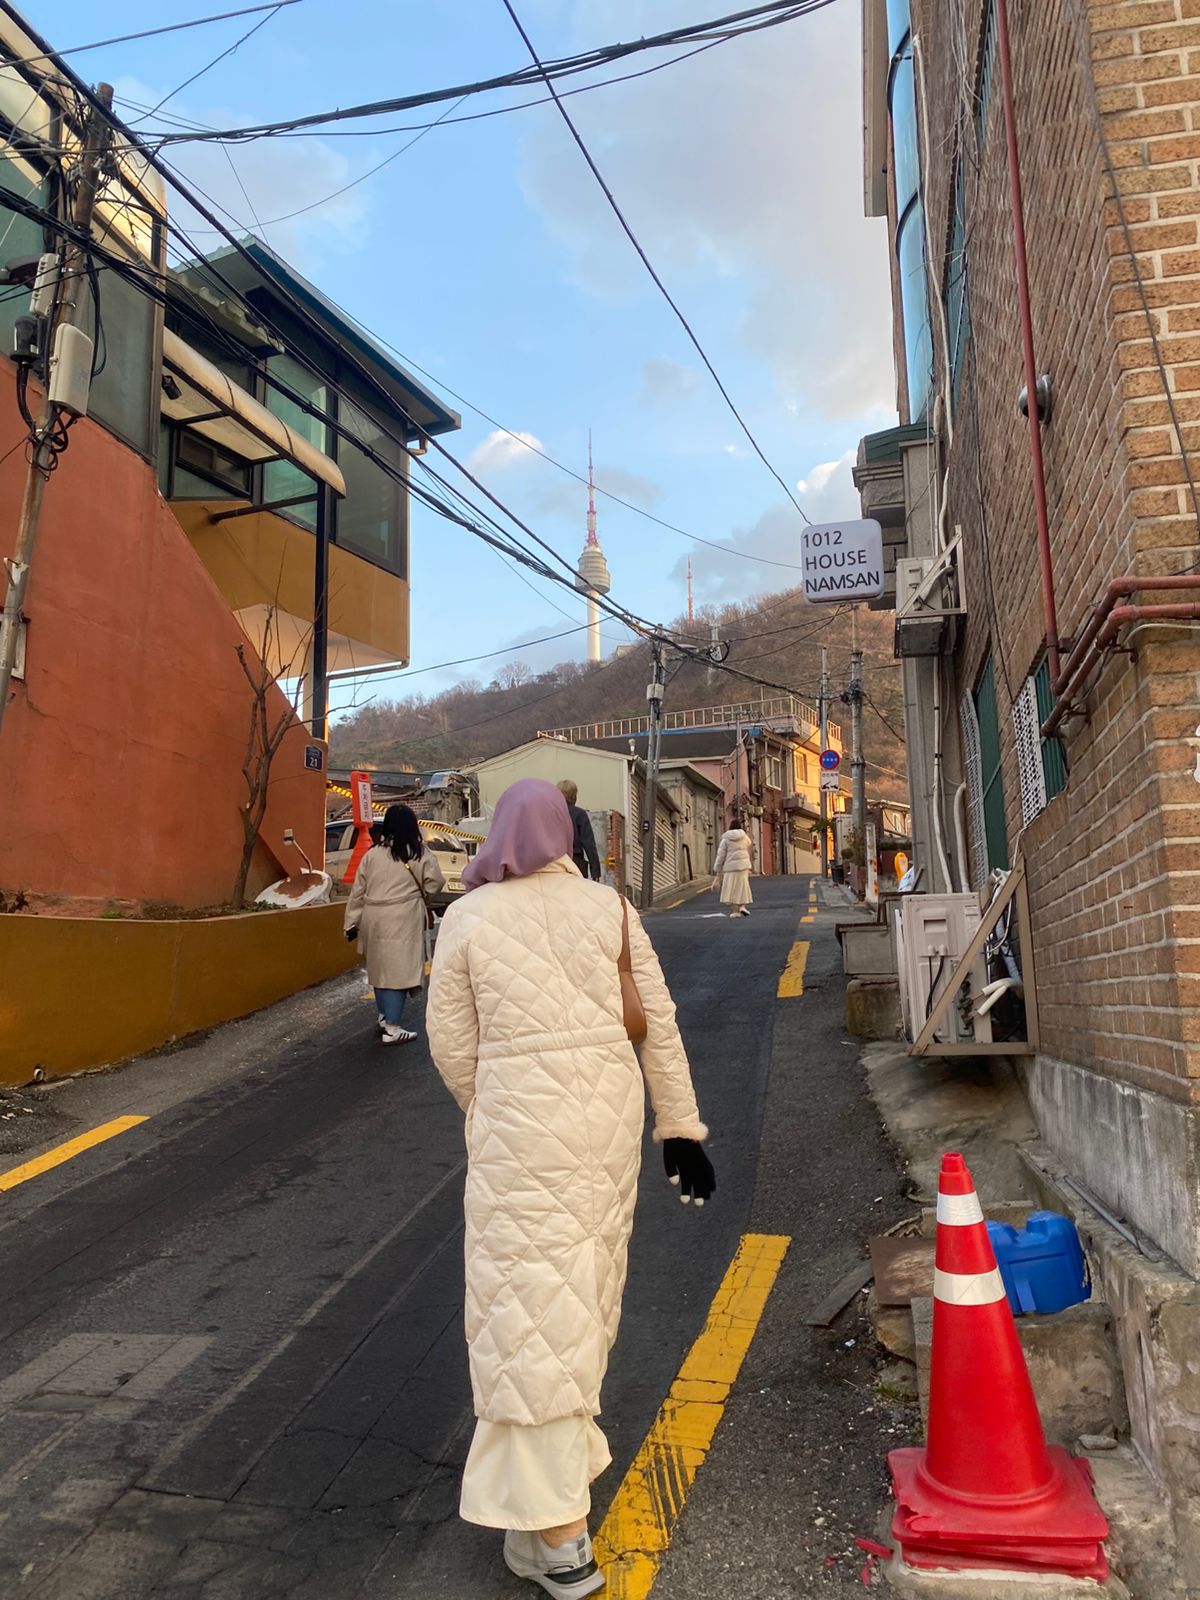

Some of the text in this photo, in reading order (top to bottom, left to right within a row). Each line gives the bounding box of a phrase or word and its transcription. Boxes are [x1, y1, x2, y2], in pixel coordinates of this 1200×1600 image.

[803, 530, 843, 548] 1012
[805, 549, 867, 571] HOUSE
[805, 571, 880, 593] NAMSAN
[309, 757, 318, 767] 21
